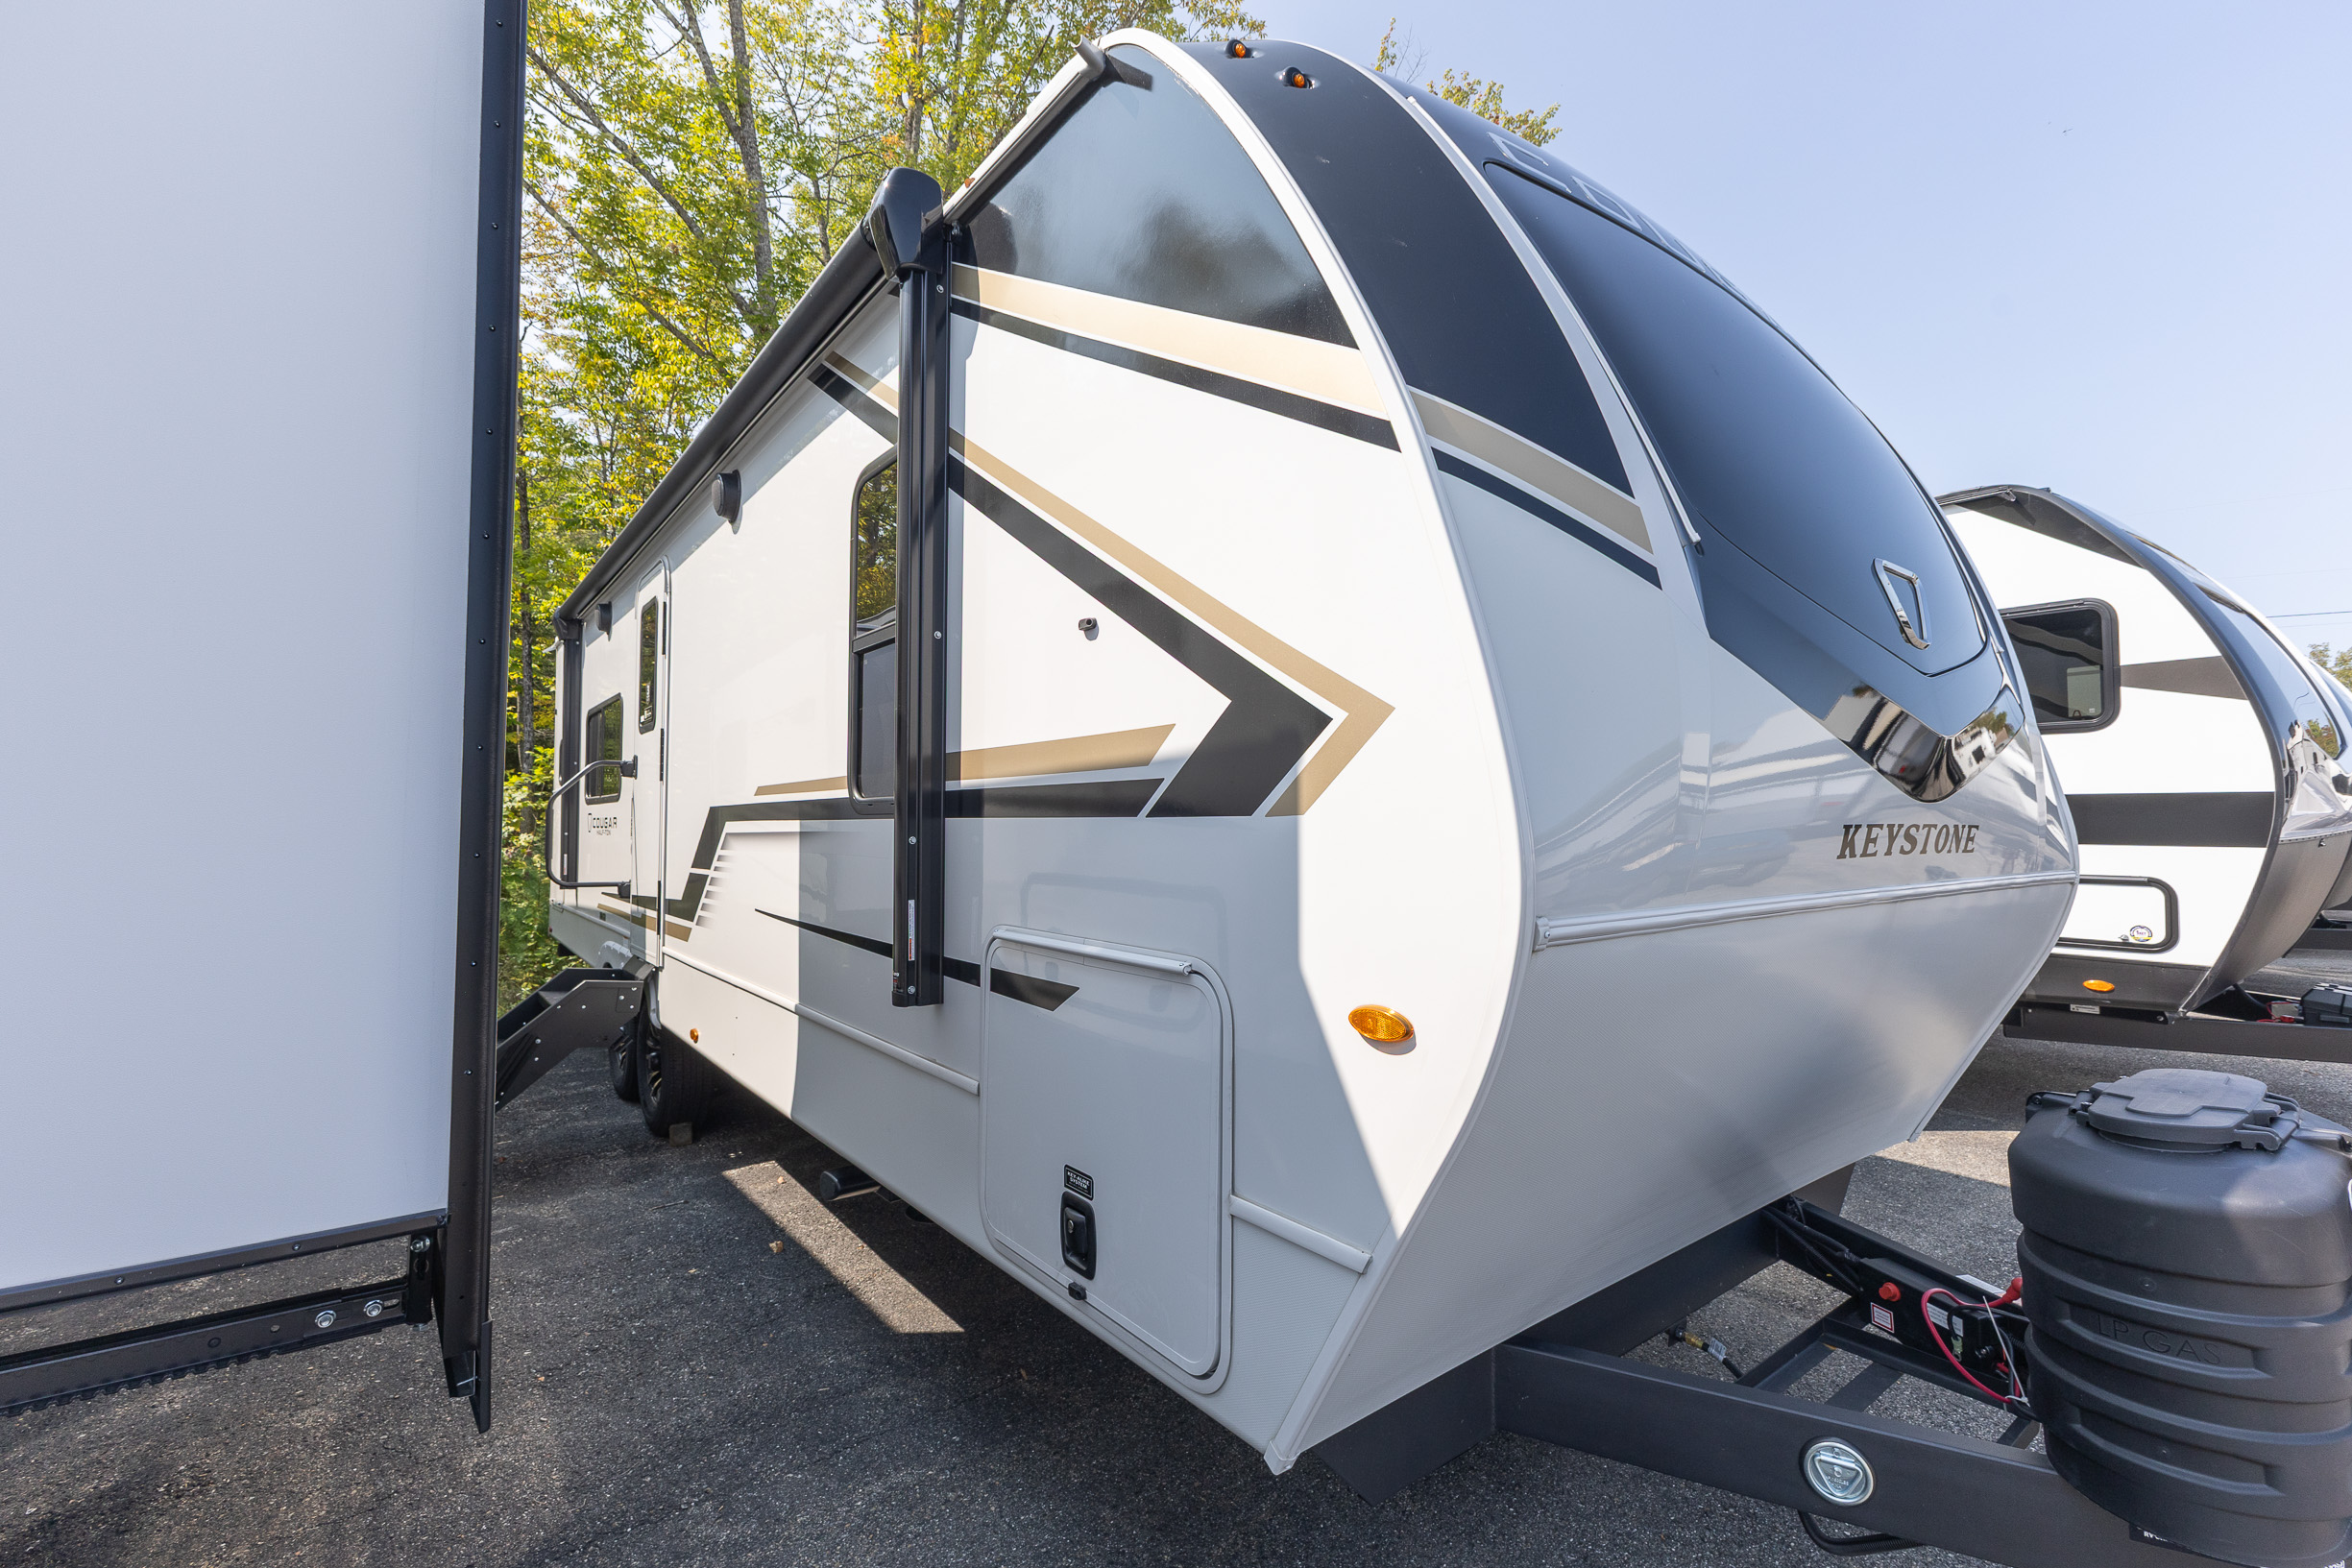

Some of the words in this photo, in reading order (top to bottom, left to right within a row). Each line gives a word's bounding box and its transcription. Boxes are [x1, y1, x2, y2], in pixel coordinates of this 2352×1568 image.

[593, 816, 618, 829] COUGAR
[1836, 823, 1980, 860] KEYSTONE
[1069, 1177, 1088, 1190] SYSTEM
[2097, 1314, 2129, 1340] LP
[2143, 1329, 2221, 1365] GAS
